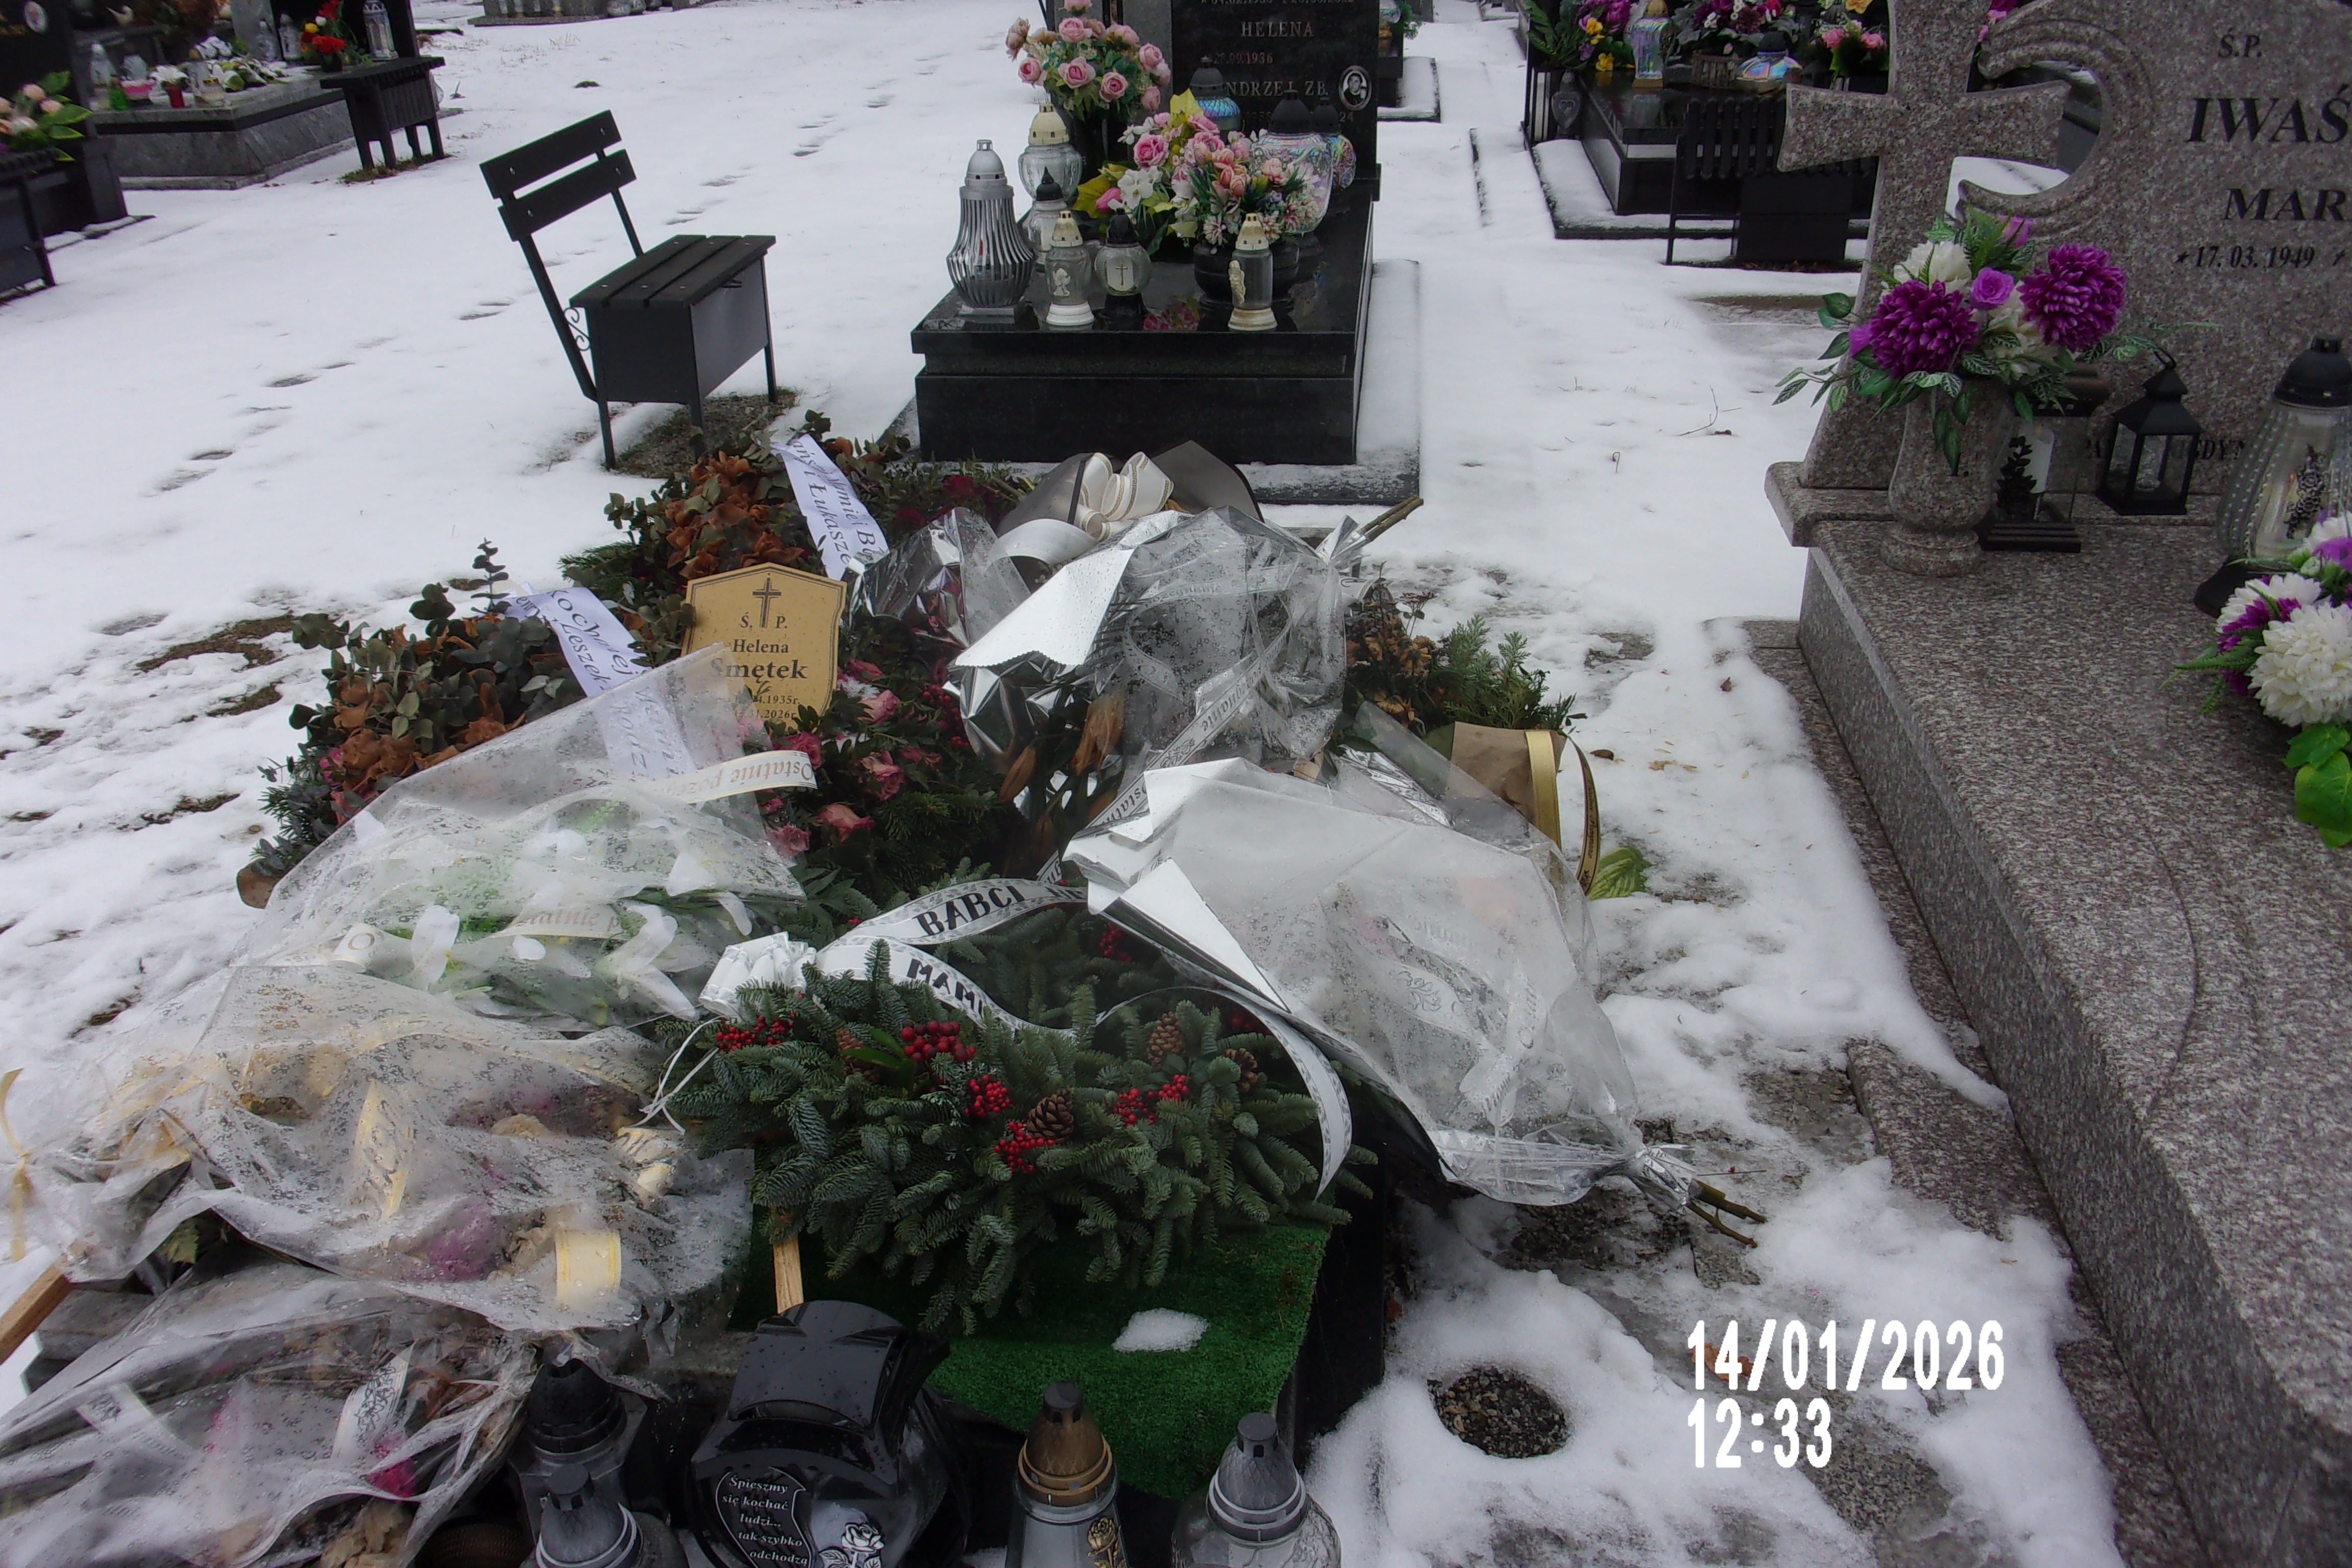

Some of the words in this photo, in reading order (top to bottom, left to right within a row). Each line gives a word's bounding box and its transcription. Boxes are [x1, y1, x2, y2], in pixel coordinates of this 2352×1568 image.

[1241, 21, 1314, 37] HELENA
[1225, 81, 1294, 97] NDRZEJ
[2183, 84, 2352, 143] IWAŚ
[807, 482, 852, 565] Łukasze
[740, 612, 753, 628] Ś.
[775, 616, 788, 629] P.
[732, 639, 789, 653] Helena
[731, 760, 813, 785] Ostatnie
[912, 886, 1025, 936] BABCI
[729, 1475, 789, 1495] Śpieszmy
[722, 1494, 739, 1506] się
[743, 1496, 789, 1511] kochać
[738, 1532, 758, 1541] tak
[761, 1533, 803, 1548] szybko
[749, 1550, 809, 1567] odchodzą
